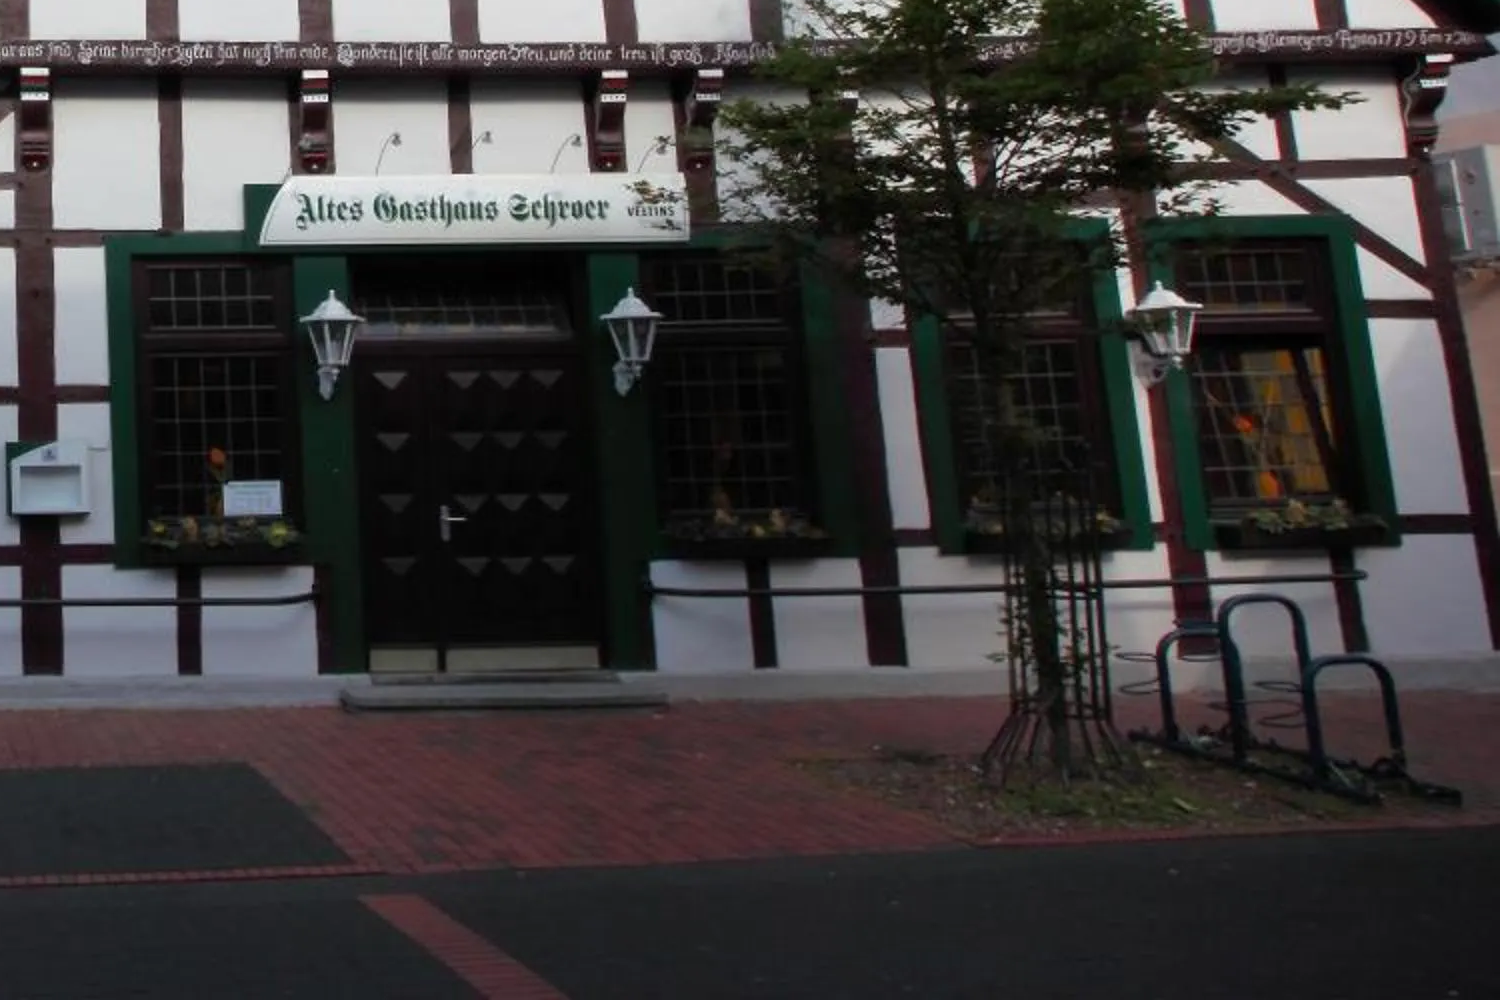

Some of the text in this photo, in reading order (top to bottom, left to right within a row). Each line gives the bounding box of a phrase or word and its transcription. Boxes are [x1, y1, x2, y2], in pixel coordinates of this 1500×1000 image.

[295, 192, 611, 230] Altes Gasthaus Schroer
[627, 206, 676, 217] VELTINS
